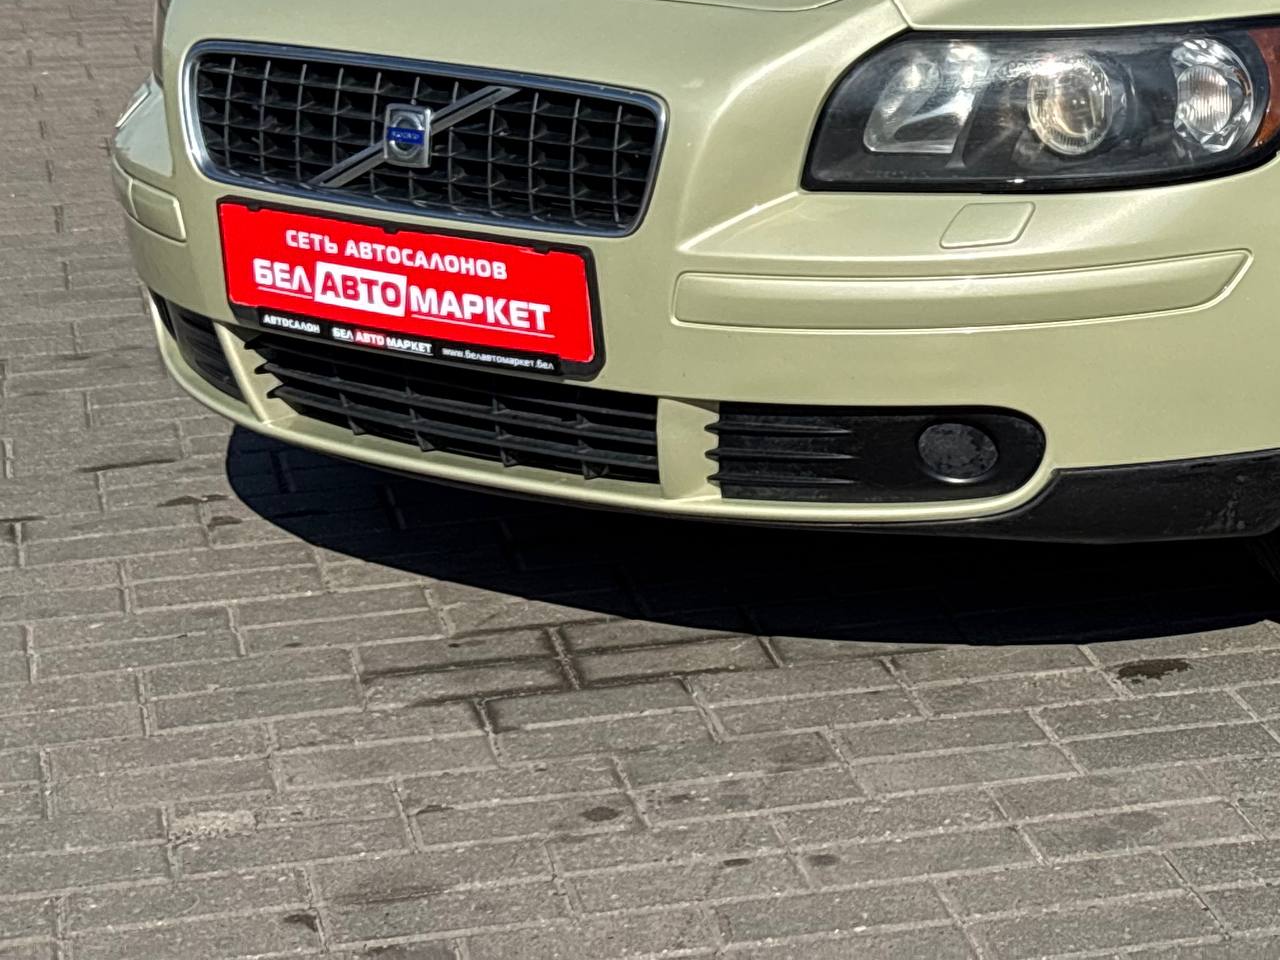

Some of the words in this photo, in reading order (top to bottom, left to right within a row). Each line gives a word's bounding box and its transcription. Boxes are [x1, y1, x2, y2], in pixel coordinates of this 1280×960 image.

[285, 229, 339, 254] СЕТЬ
[344, 239, 508, 280] АВТОСАЛОНОВ
[263, 314, 320, 334] АВТОСАЛОН
